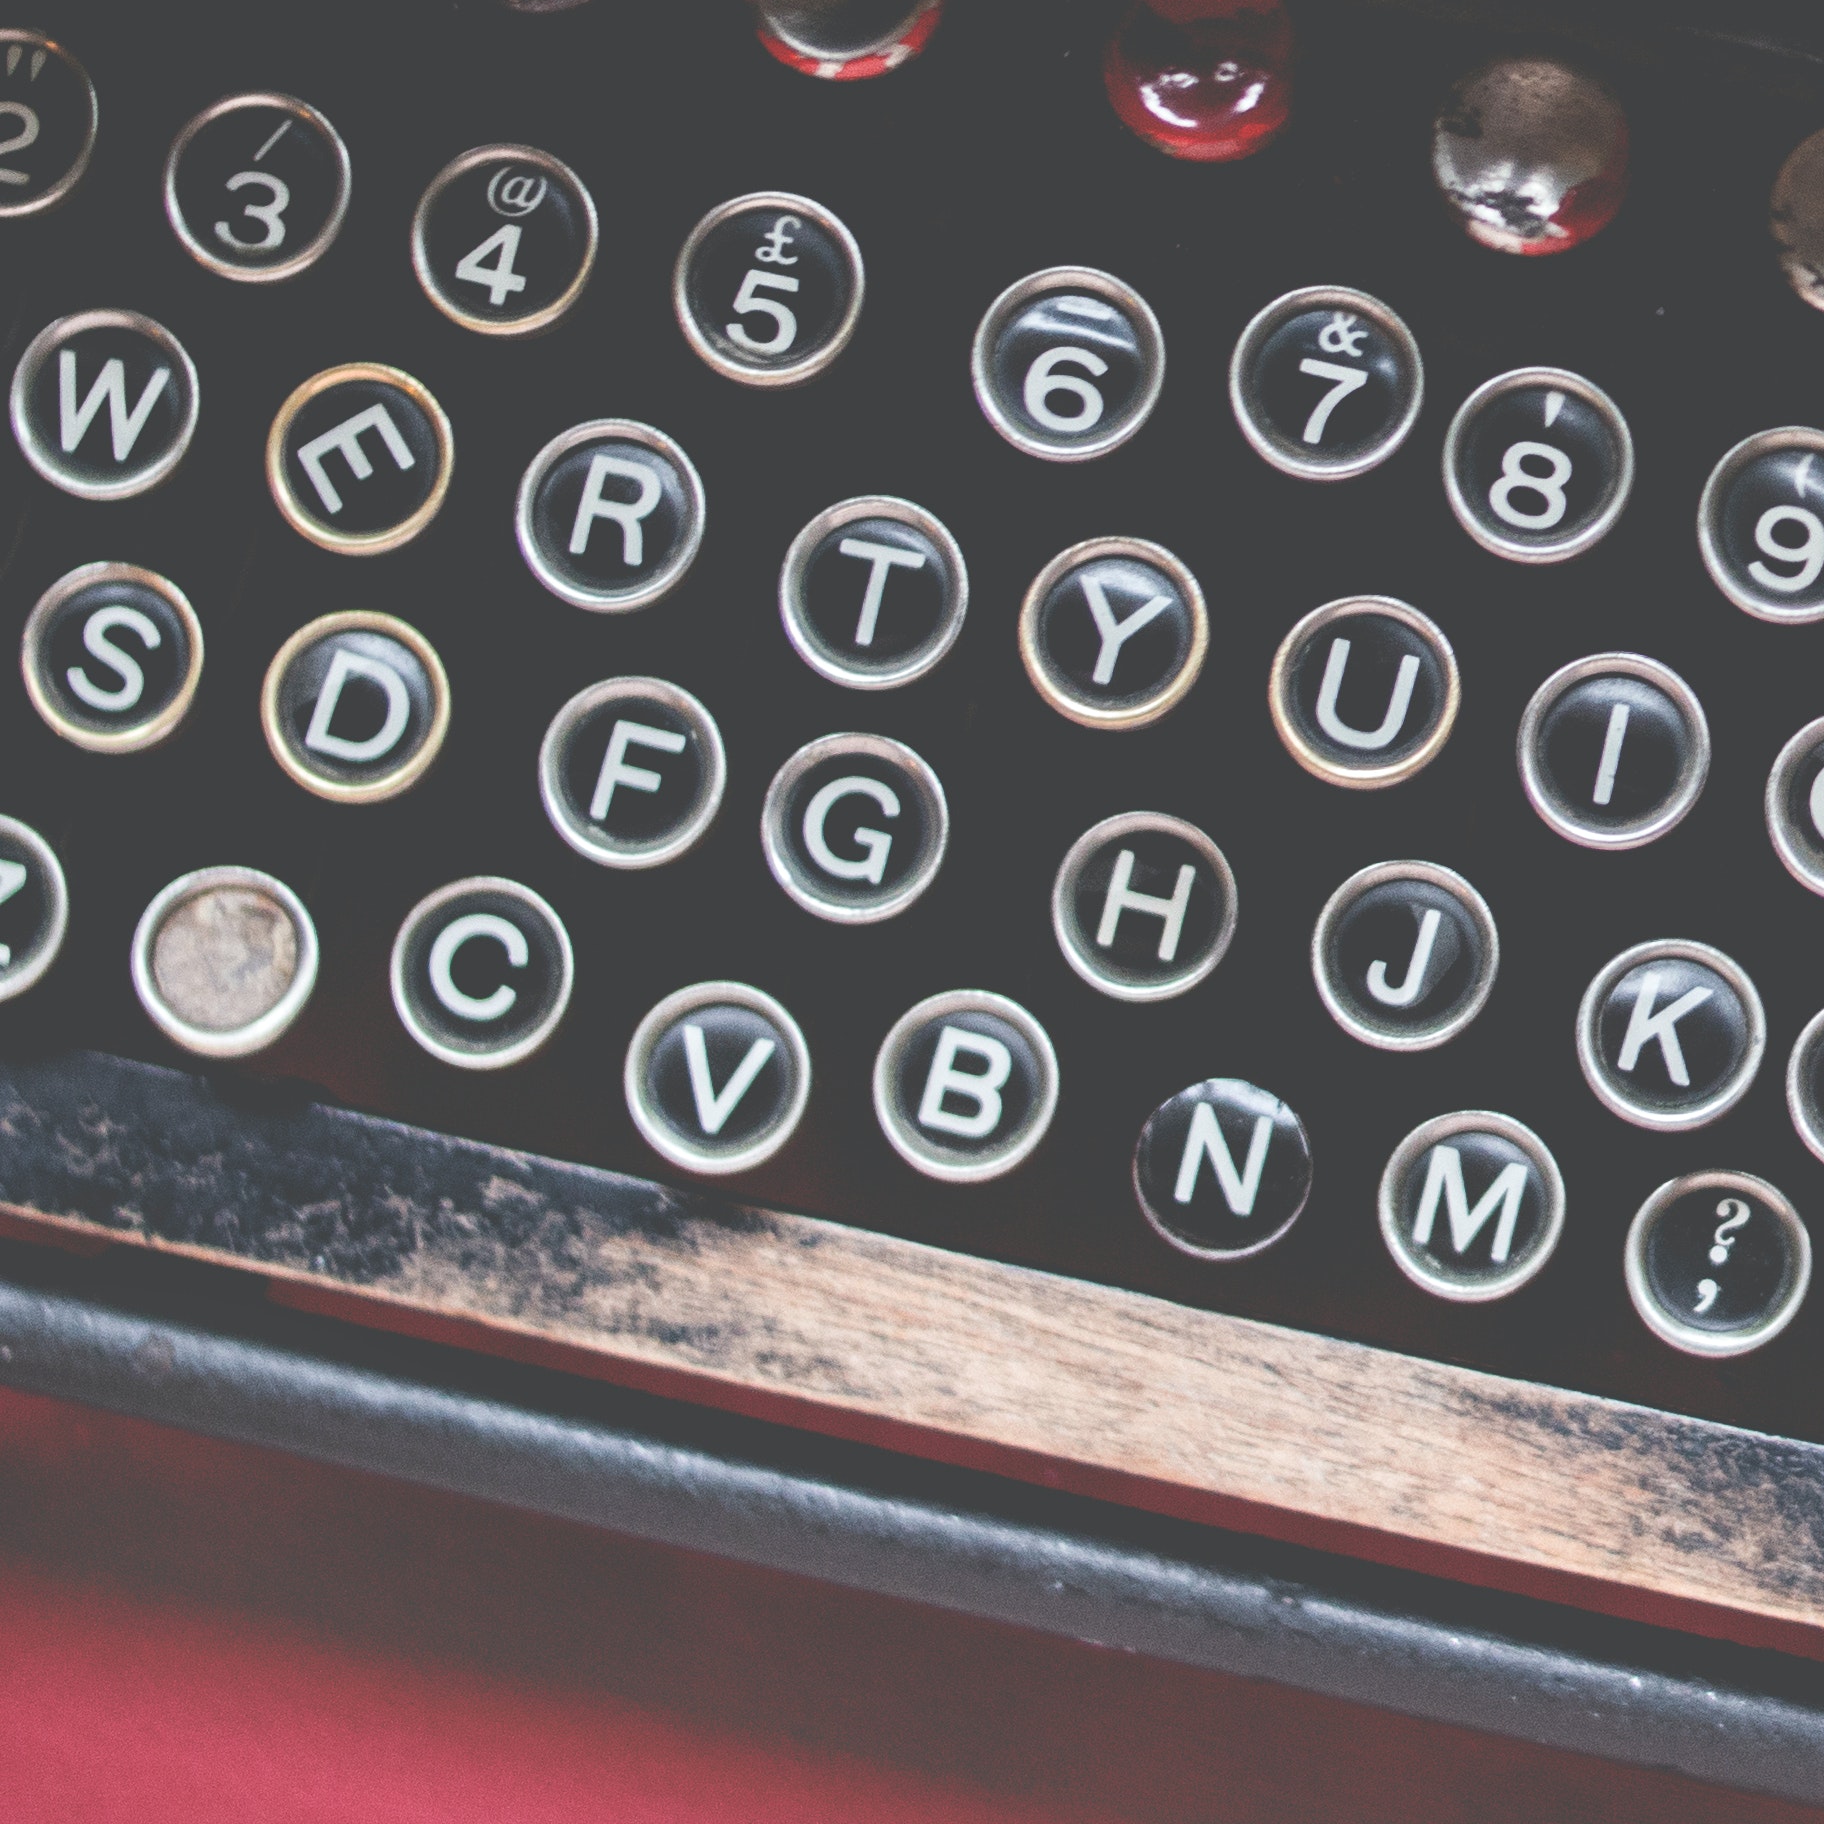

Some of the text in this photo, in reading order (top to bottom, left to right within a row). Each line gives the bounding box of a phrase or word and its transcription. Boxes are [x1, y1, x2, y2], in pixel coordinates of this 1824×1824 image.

[213, 170, 291, 253] 3
[487, 164, 548, 217] @
[754, 214, 802, 266] £
[455, 223, 528, 306] 4
[725, 269, 800, 355] 5
[1022, 345, 1109, 433] 6
[1317, 312, 1369, 358] &
[57, 348, 170, 463] W
[1298, 357, 1369, 445] 7
[296, 402, 416, 515] E
[568, 453, 662, 567] R
[1488, 441, 1573, 530] 8
[838, 536, 926, 647] T
[1079, 573, 1173, 686] Y
[66, 604, 162, 713] S
[304, 648, 411, 762] D
[1315, 637, 1421, 751] U
[589, 719, 687, 820] F
[1592, 702, 1631, 806] I
[802, 776, 901, 885] G
[1096, 849, 1196, 962] H
[1365, 908, 1442, 1007] J
[428, 913, 529, 1022] C
[682, 1024, 776, 1135] V
[917, 1025, 1013, 1139] B
[1616, 973, 1715, 1088] K
[1173, 1101, 1274, 1216] N
[1412, 1144, 1529, 1263] M
